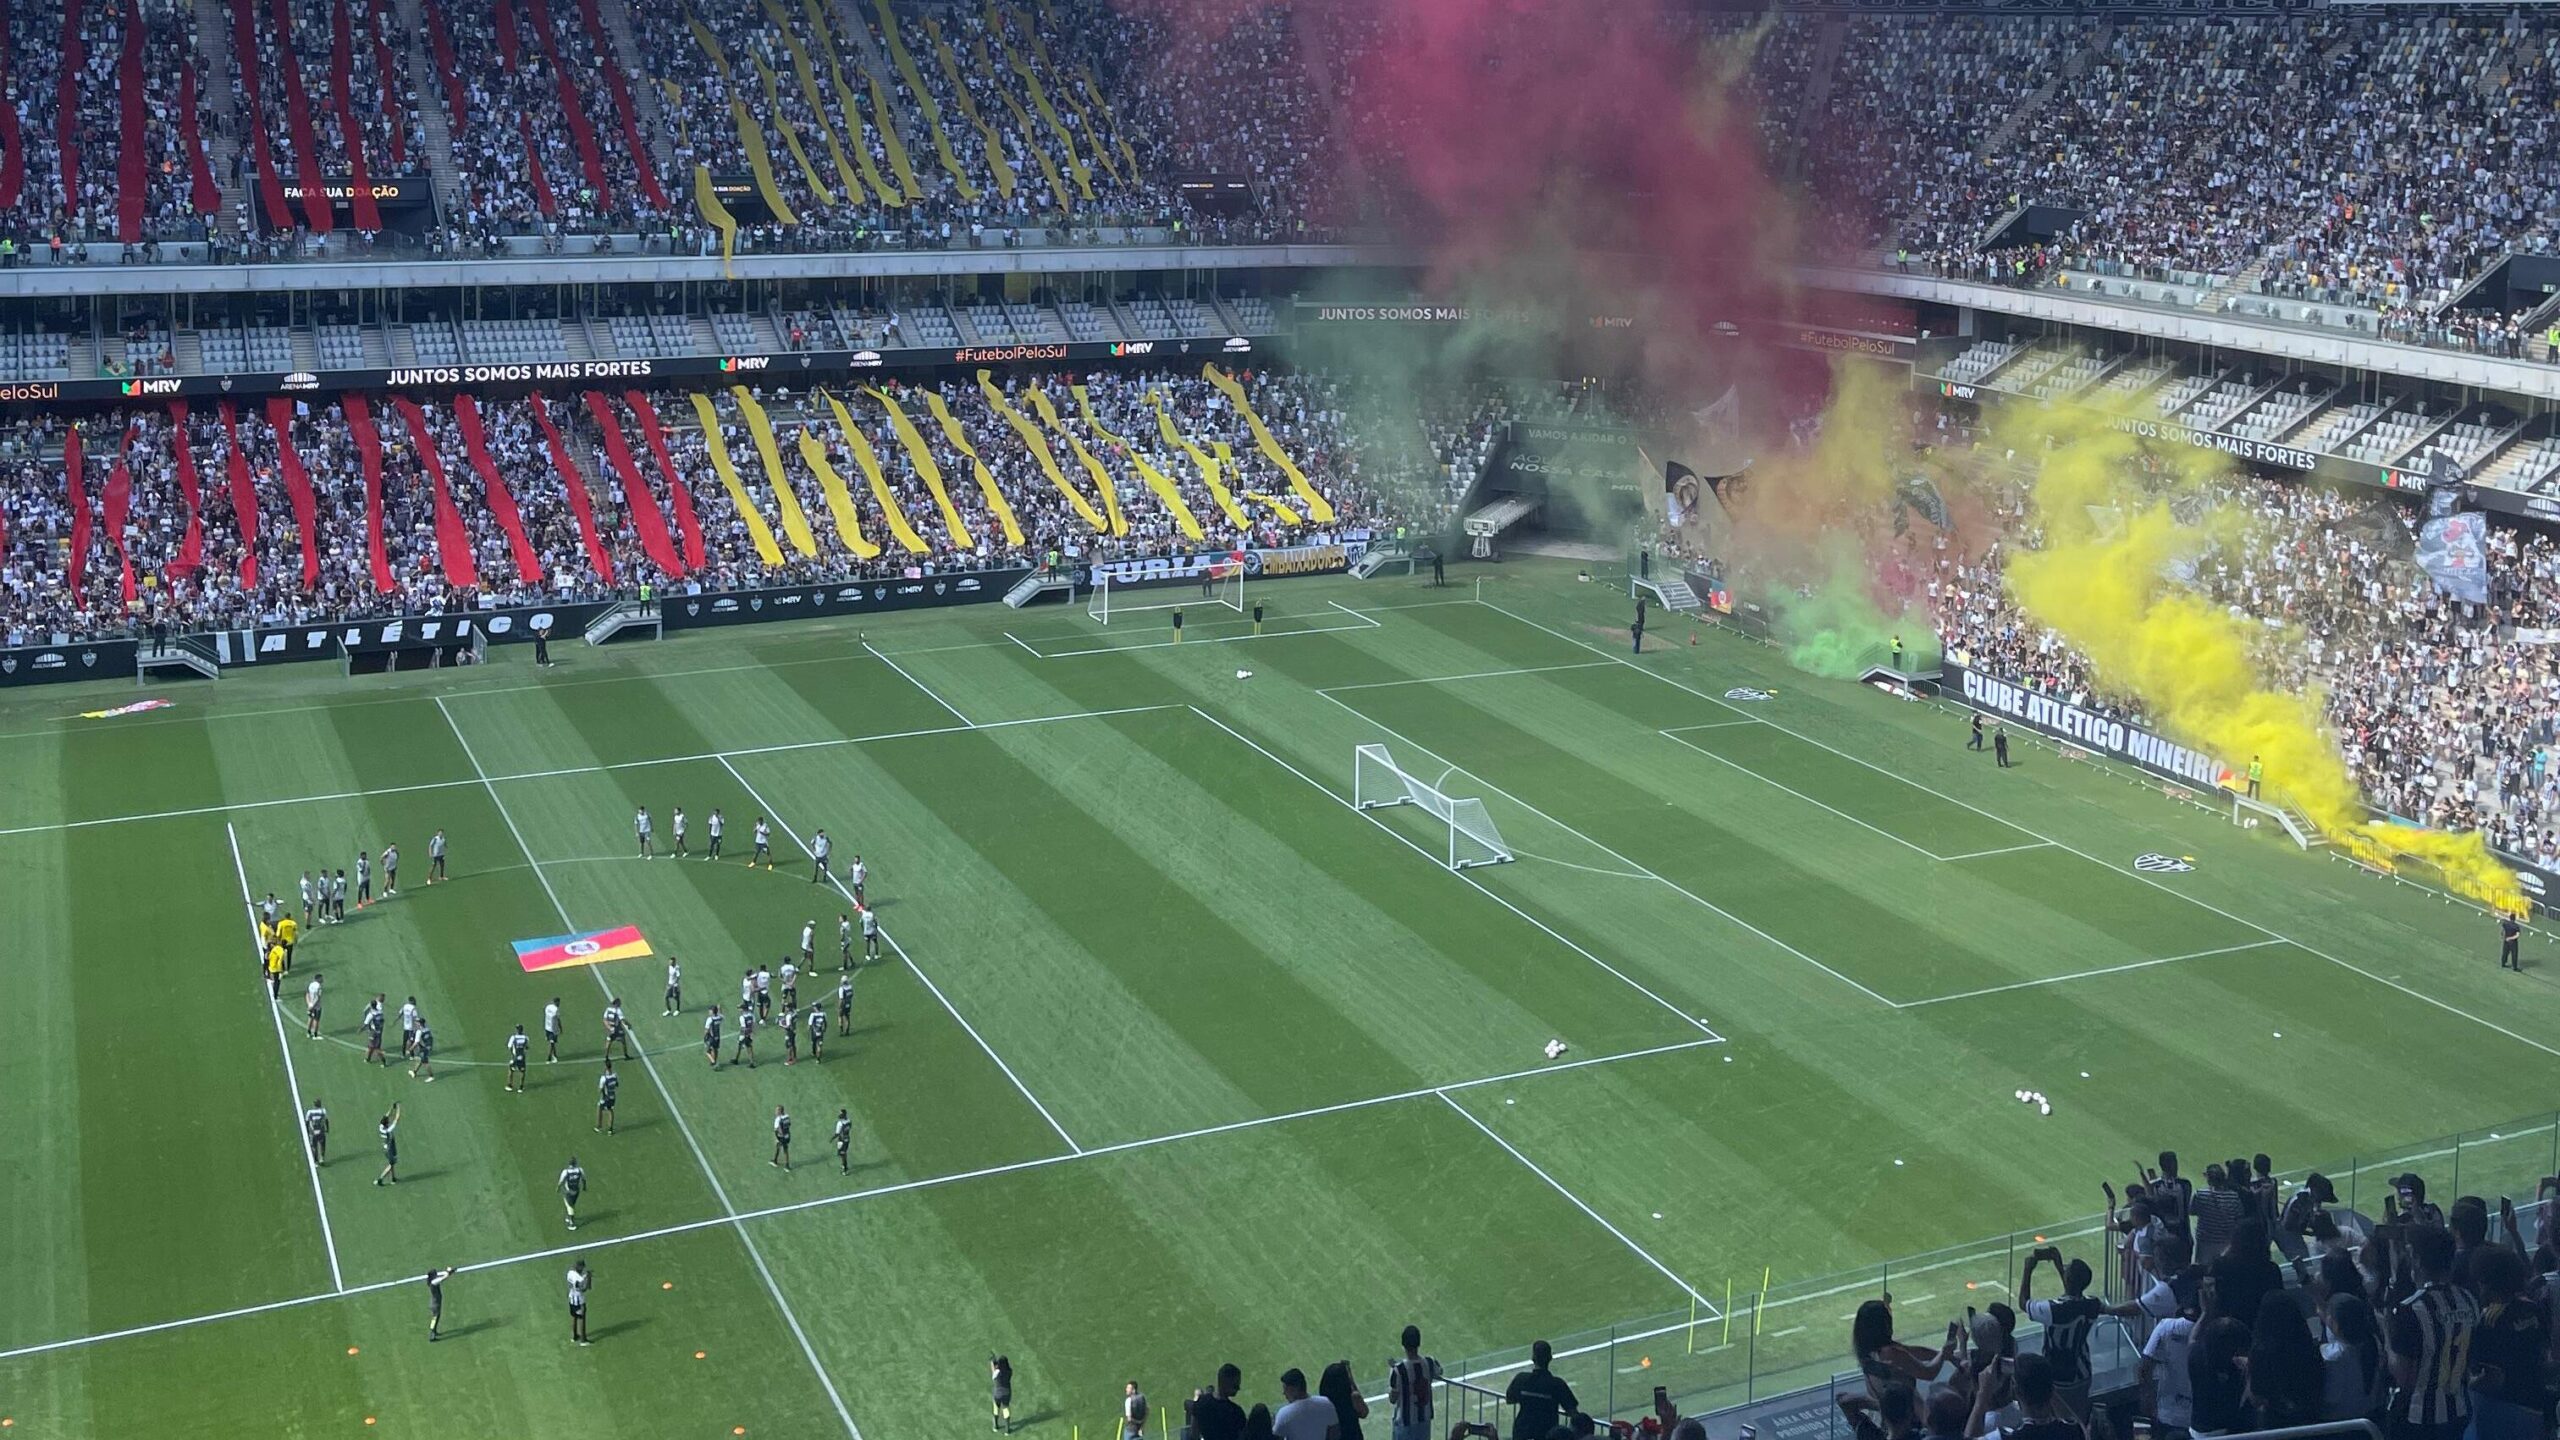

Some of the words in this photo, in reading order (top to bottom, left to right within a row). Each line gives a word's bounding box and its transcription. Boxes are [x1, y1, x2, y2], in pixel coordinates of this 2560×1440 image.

[1318, 307, 1376, 321] JUNTOS
[1379, 307, 1432, 321] SOMOS
[1436, 308, 1471, 320] MAIS
[1125, 341, 1154, 355] MRV
[1800, 331, 1896, 355] #FutebolPeloSul
[955, 344, 1067, 363] #FutebolPeloSul
[737, 356, 770, 371] MRV
[387, 367, 460, 385] JUNTOS
[464, 365, 532, 382] SOMOS
[536, 363, 580, 379] MAIS
[585, 360, 652, 377] FORTES
[143, 379, 182, 393] MRV
[1952, 385, 1976, 400] MRV
[1528, 428, 1568, 441] VAMOS
[2104, 414, 2157, 438] JUNTOS
[2160, 425, 2213, 449] SOMOS
[2215, 434, 2254, 457] MAIS
[2256, 442, 2316, 470] FORTES
[1510, 461, 1573, 477] NOSSA
[1962, 670, 2025, 717] CLUBE
[2025, 694, 2124, 752] ATLÉTICO
[2127, 727, 2227, 788] MINEIRO
